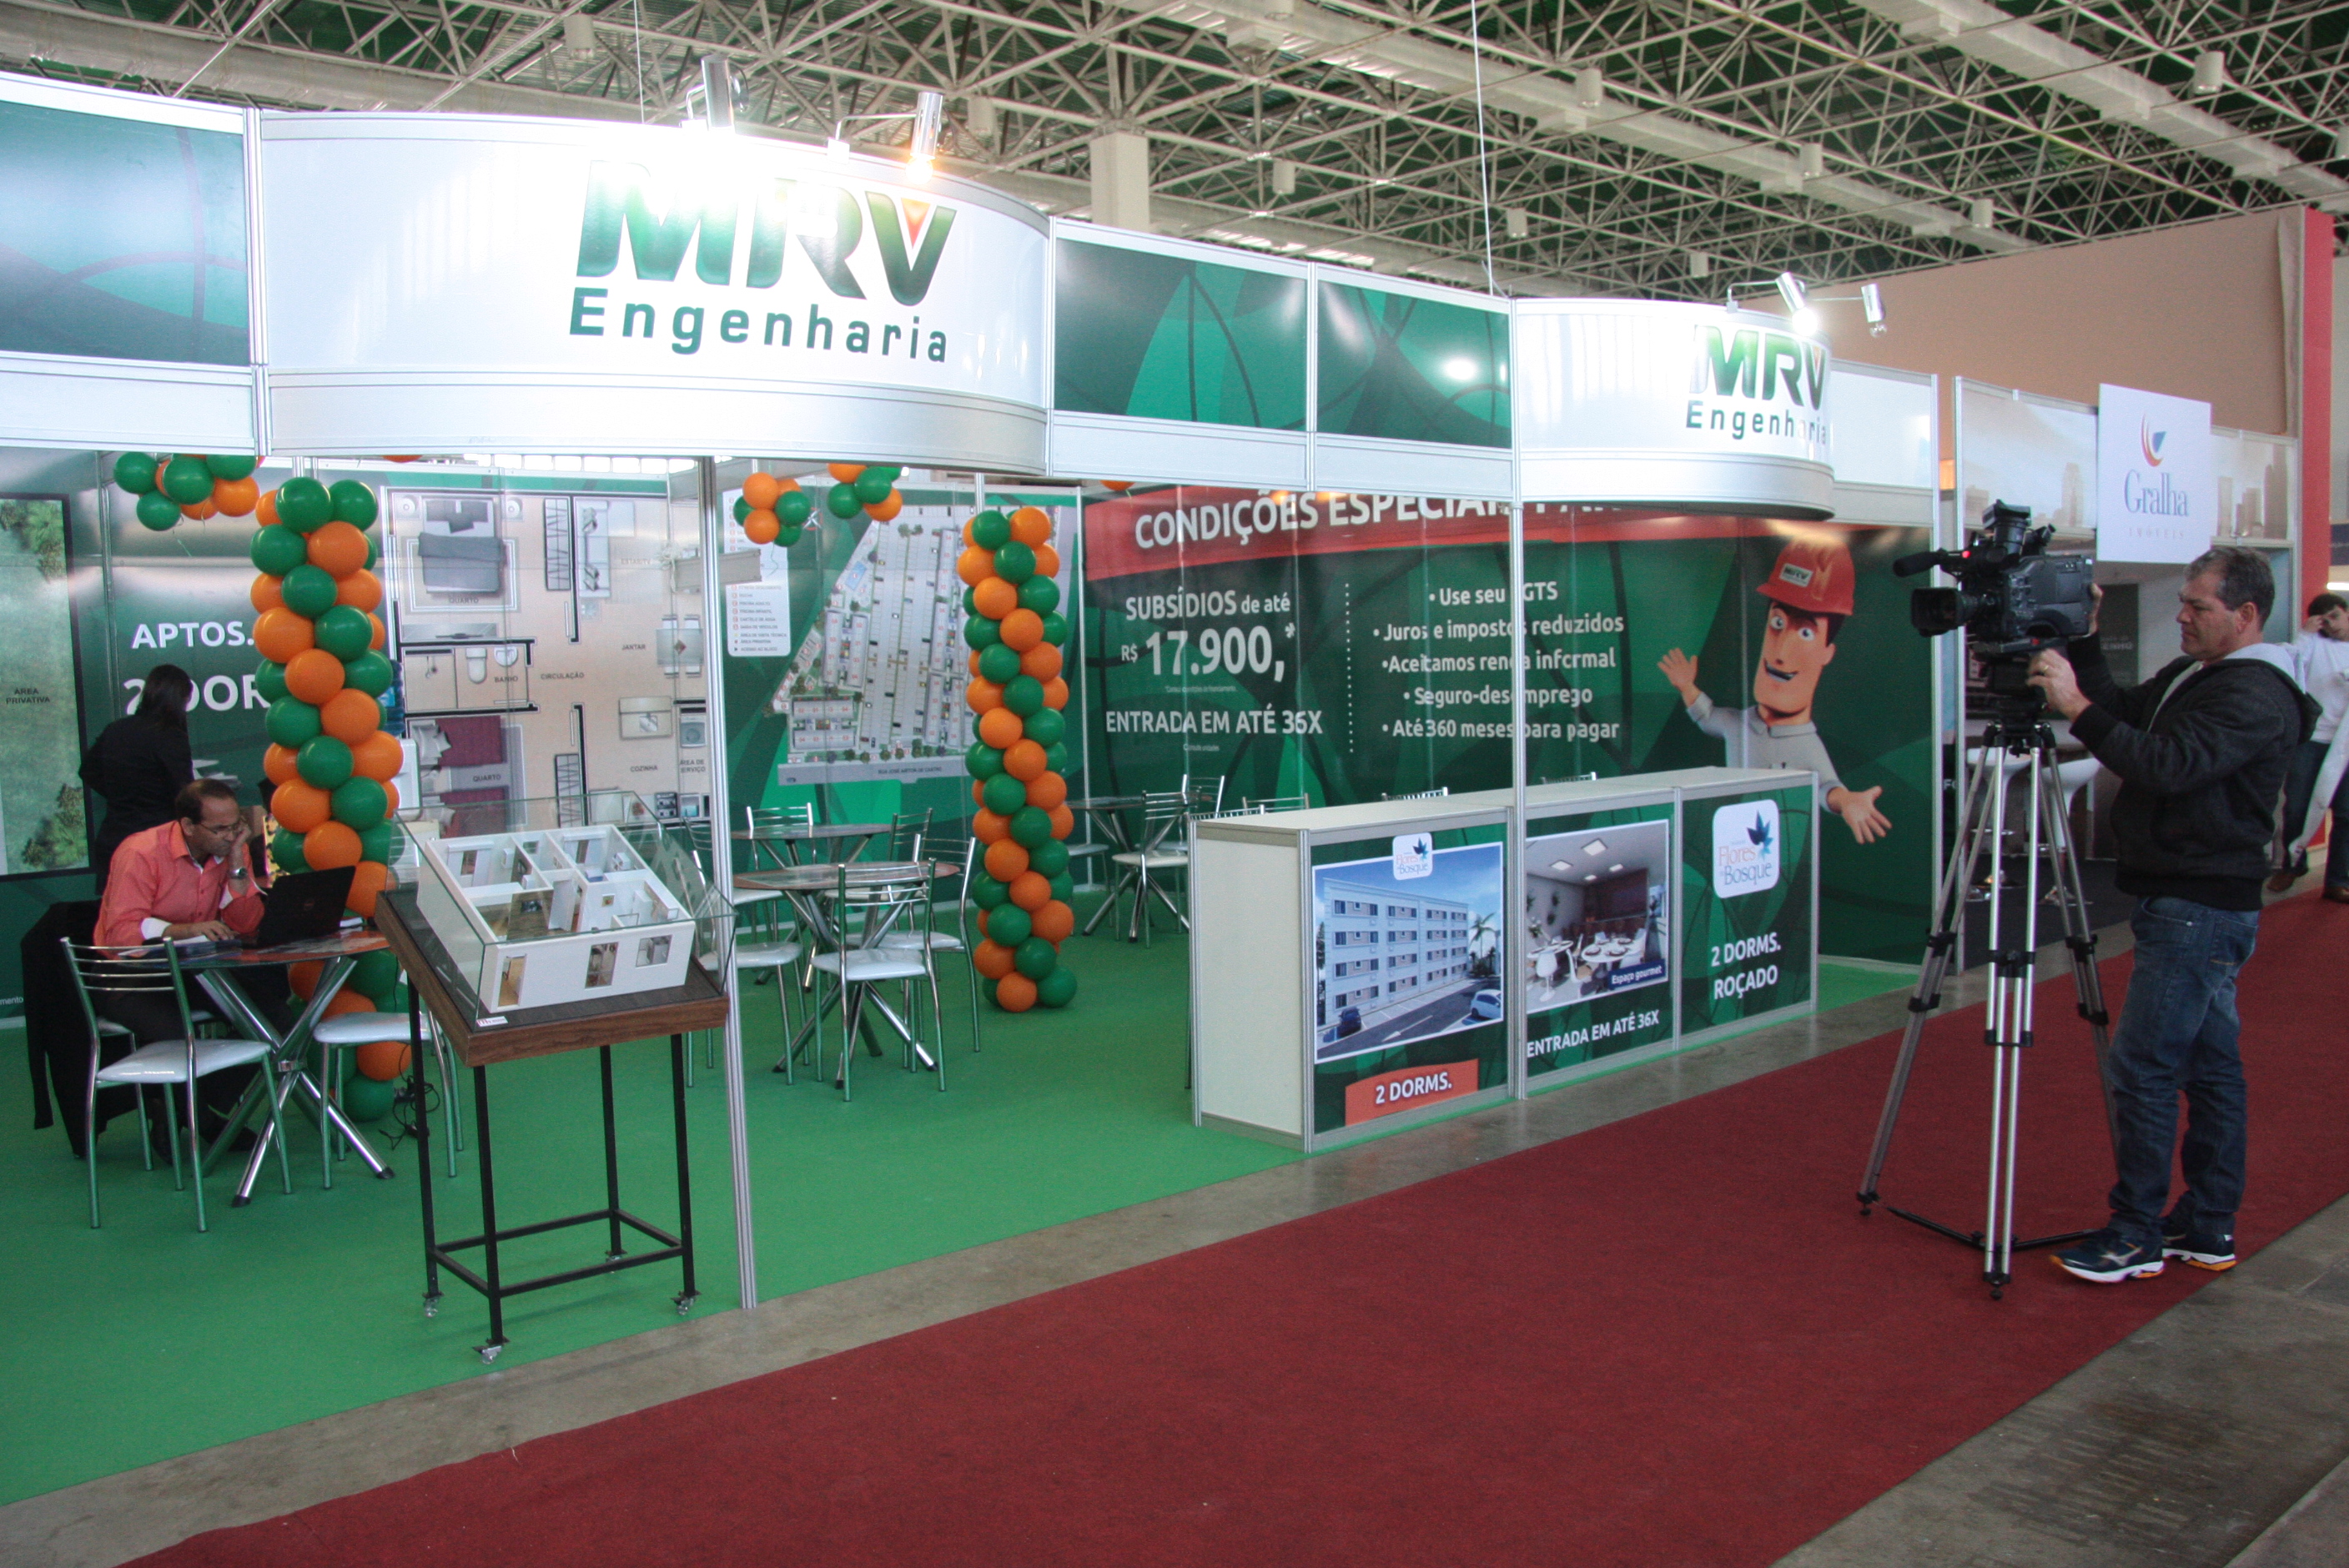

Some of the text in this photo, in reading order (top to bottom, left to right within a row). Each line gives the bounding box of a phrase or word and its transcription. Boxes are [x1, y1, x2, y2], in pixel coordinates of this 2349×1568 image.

[576, 160, 957, 306] MRV
[570, 287, 947, 363] Engenharia
[1689, 324, 1827, 410] MRV
[2124, 470, 2189, 516] Gralha
[1134, 489, 1319, 549] CONDIÇÕES
[1126, 586, 1290, 621] SUBSÍDIOS de até
[1439, 581, 1558, 606] Use seu GTS
[131, 621, 254, 649] APTOS.
[1383, 624, 1427, 641] Juros
[1433, 626, 1443, 639] e
[1532, 612, 1624, 635] reduzidos
[1121, 643, 1138, 663] R$
[1388, 653, 1476, 672] Aceitamos
[1537, 647, 1617, 669] informal
[1414, 685, 1593, 708] Seguro-desmprego
[1106, 703, 1323, 734] ENTRADA EM ATÉ 36X
[1392, 718, 1423, 737] Até
[1426, 719, 1456, 737] 360
[1567, 723, 1620, 741] pagar
[473, 774, 500, 782] QUARTO
[1724, 862, 1772, 886] Bosque
[1711, 932, 1781, 967] 2 DORMS.
[1611, 965, 1662, 985] Espaço gourmet
[1714, 964, 1778, 999] ROÇADO
[1527, 1009, 1660, 1058] ENTRADA EM ATÉ 36X
[1376, 1071, 1452, 1104] 2 DORMS.
